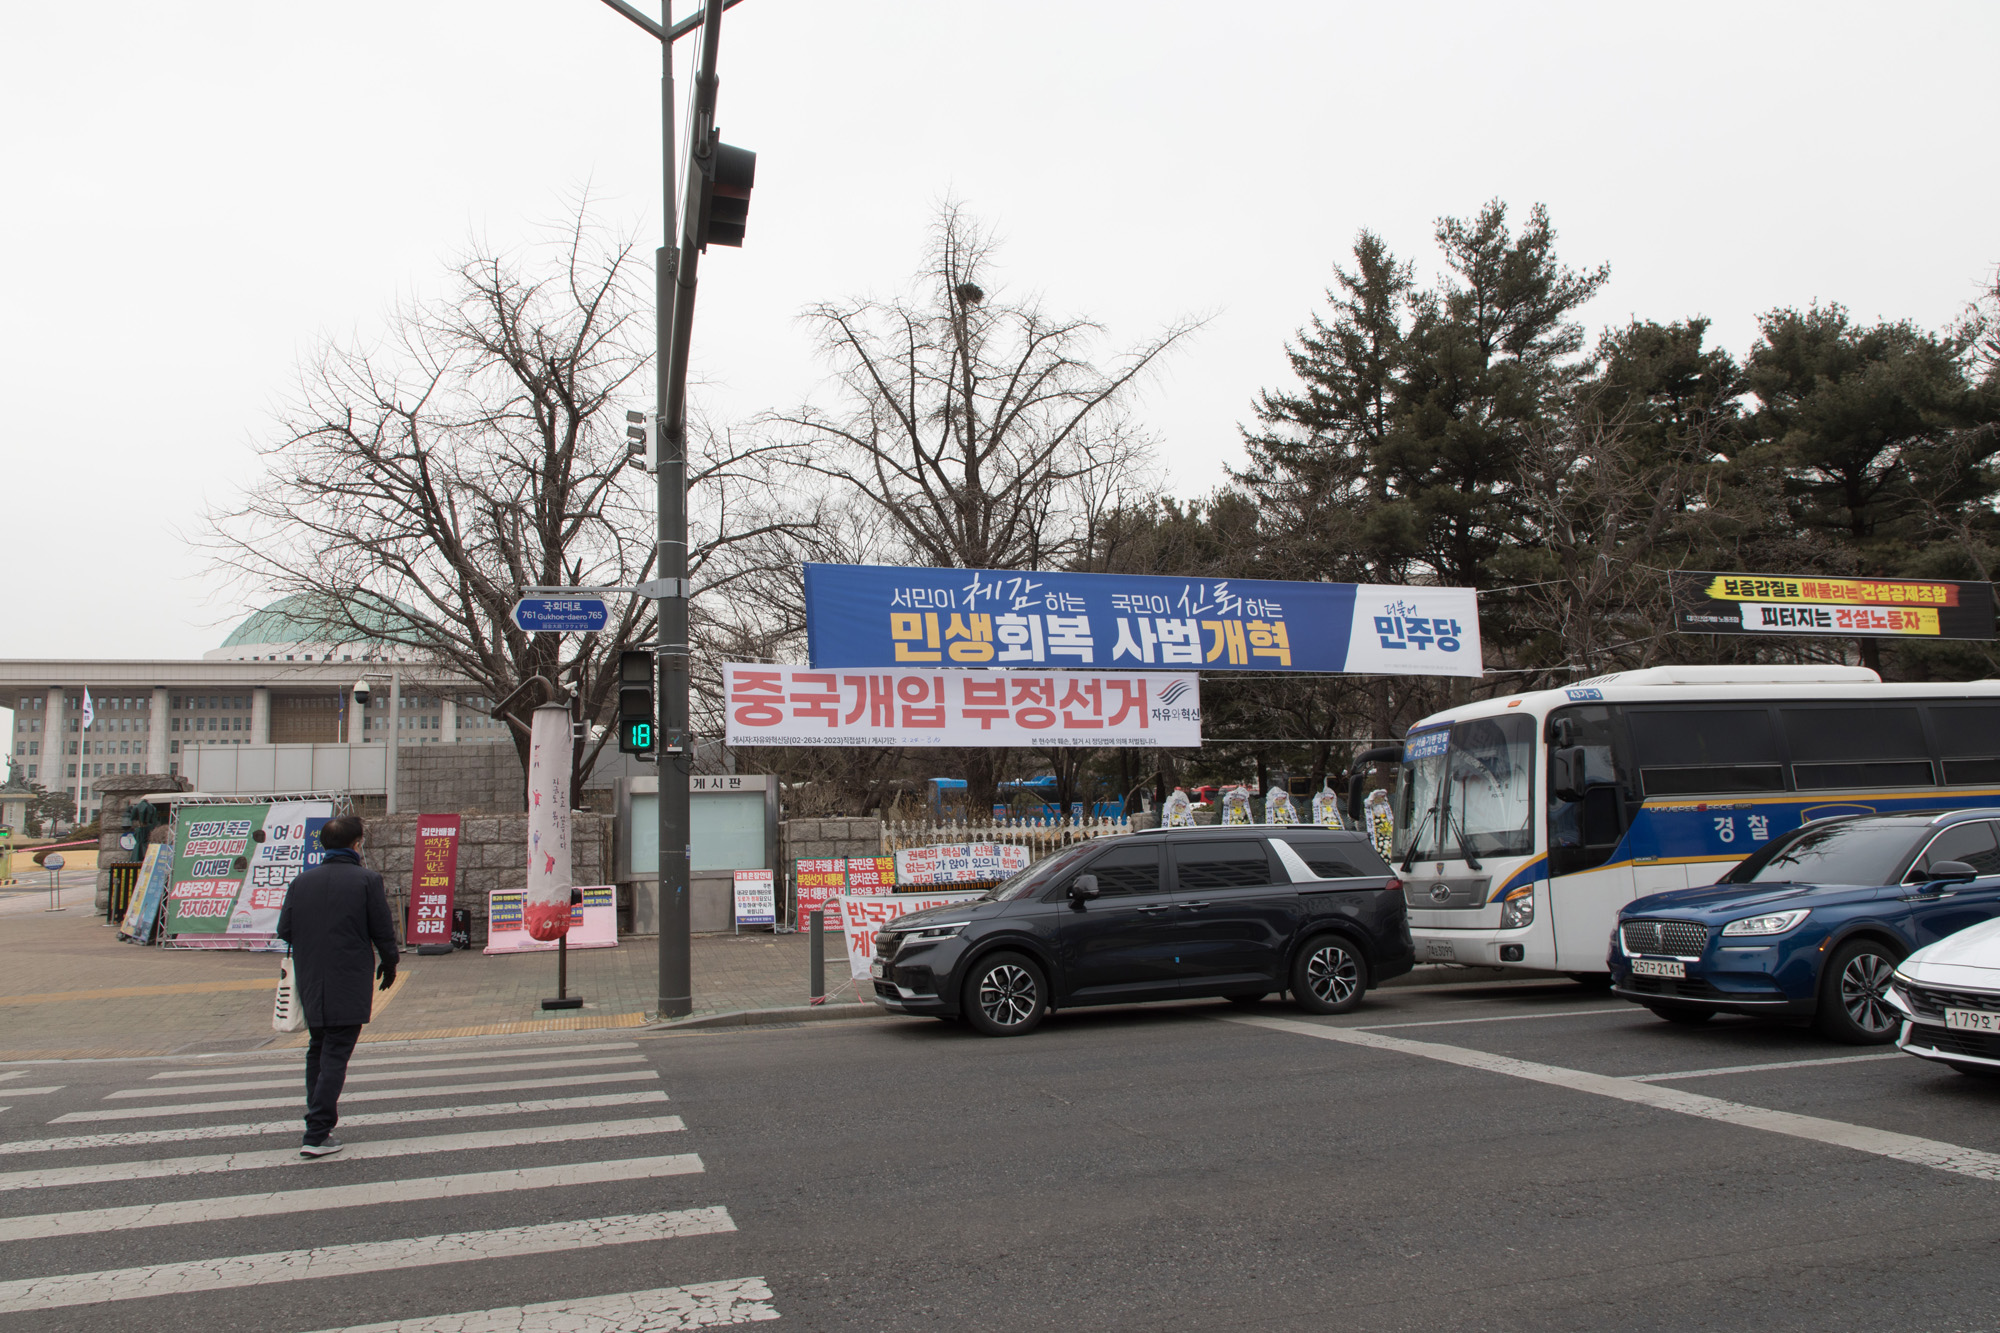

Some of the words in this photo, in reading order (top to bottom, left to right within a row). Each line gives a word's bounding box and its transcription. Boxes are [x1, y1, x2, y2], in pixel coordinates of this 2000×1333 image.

[1724, 579, 1800, 597] 보증갑질로
[1802, 582, 1858, 599] 배불리는
[1860, 584, 1947, 603] 건설공제조합
[542, 601, 582, 612] 국회대로
[891, 587, 956, 609] 서민이
[1111, 594, 1171, 614] 국민이
[522, 611, 536, 619] 761
[588, 611, 602, 619] 765
[1384, 600, 1417, 618] 더불어
[1761, 607, 1832, 627] 피터지는
[1836, 609, 1920, 630] 건설노동자
[890, 612, 1094, 663] 민생회복
[1112, 617, 1292, 666] 사법개혁
[1373, 616, 1462, 652] 민주당
[731, 670, 946, 728] 중국개입
[961, 677, 1149, 730] 부정선거
[1570, 690, 1600, 698] 43기-3
[1151, 708, 1200, 722] 자유와혁신
[632, 723, 650, 747] 18
[871, 736, 897, 745] 게시기간:
[693, 777, 741, 789] 게시판
[226, 820, 251, 837] 죽은
[1713, 815, 1769, 843] 경찰
[183, 839, 247, 857] 암흑의시대!
[907, 849, 938, 861] 권력의
[941, 846, 971, 858] 핵심에
[973, 845, 1001, 857] 신원을
[1002, 846, 1011, 857] 알
[1013, 847, 1021, 856] 수
[192, 858, 232, 877] 이재명
[797, 860, 814, 872] 국민의
[815, 860, 833, 872] 주권을
[848, 858, 875, 871] 국민은
[876, 857, 894, 870] 반중
[905, 860, 946, 873] 없는자가
[949, 859, 968, 870] 앉아
[972, 858, 999, 869] 있으니
[1002, 858, 1025, 869] 헌법이
[252, 865, 304, 887] 부정부
[797, 873, 823, 886] 부정선거
[849, 872, 879, 886] 정치꾼은
[913, 872, 953, 884] 파괴되고
[956, 870, 986, 881] 주권도
[171, 881, 216, 898] 사회주의
[215, 879, 240, 897] 독재
[797, 887, 810, 900] 우리
[810, 887, 828, 900] 대통령
[255, 890, 287, 908] 척결
[419, 894, 447, 905] 그분을
[176, 898, 230, 918] 저지하자!
[417, 906, 447, 919] 수사
[417, 920, 445, 934] 하라
[1657, 962, 1681, 976] 2141
